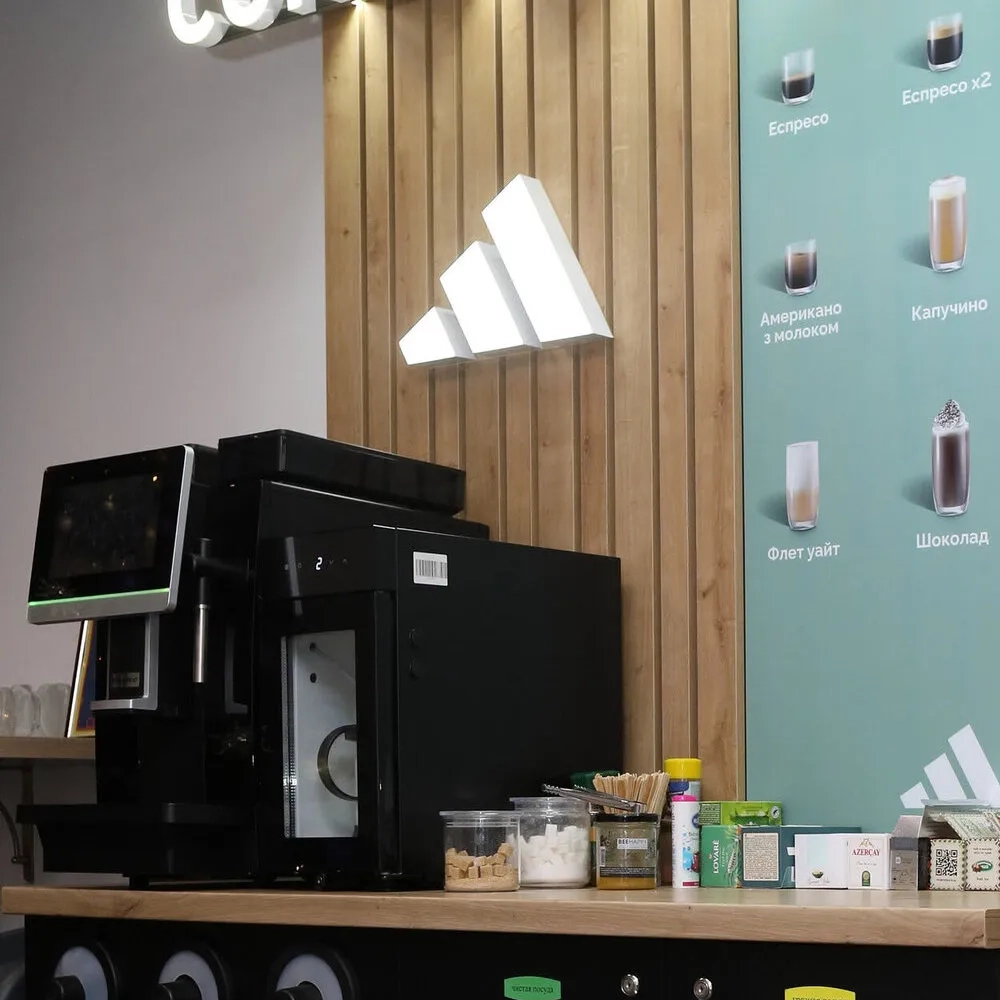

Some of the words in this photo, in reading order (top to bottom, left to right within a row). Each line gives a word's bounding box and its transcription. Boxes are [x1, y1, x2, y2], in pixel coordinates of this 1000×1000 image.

[902, 78, 968, 106] Еспресо
[768, 112, 829, 136] Еспресо
[760, 302, 842, 327] Американо
[912, 298, 988, 321] Капучино
[763, 332, 771, 345] з
[774, 321, 839, 343] молоком
[916, 529, 989, 549] Шоколад
[315, 556, 323, 571] 2
[767, 545, 805, 562] Флет
[807, 542, 841, 563] уайт
[511, 985, 532, 994] чистая
[532, 986, 554, 994] посуда
